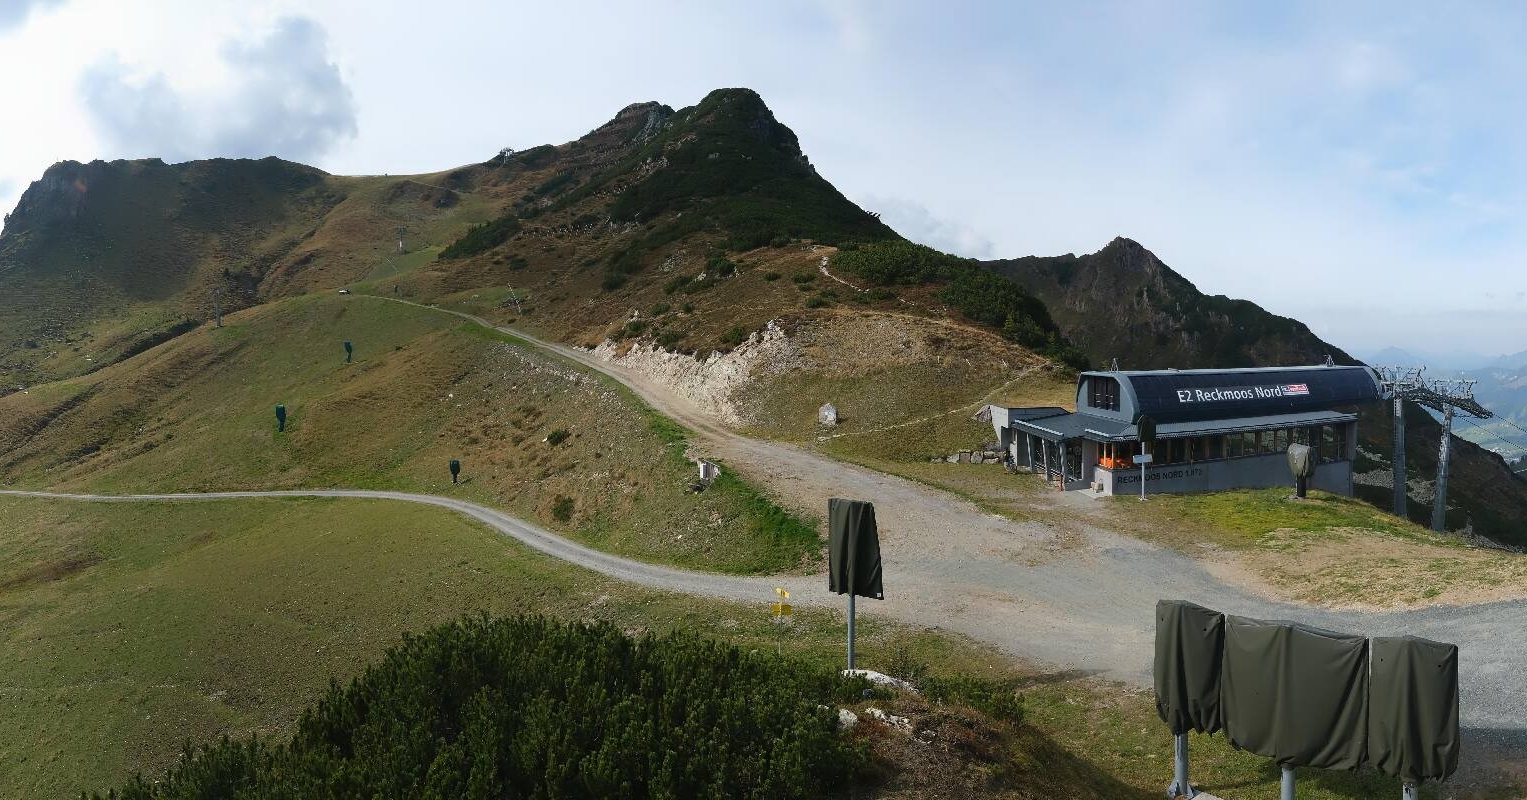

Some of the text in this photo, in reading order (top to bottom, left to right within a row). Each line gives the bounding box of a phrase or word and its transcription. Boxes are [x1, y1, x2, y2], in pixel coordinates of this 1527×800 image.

[1176, 390, 1193, 402] E2
[1195, 388, 1254, 402] Reckmoos
[1254, 385, 1282, 398] Nord
[1162, 471, 1184, 480] NORD
